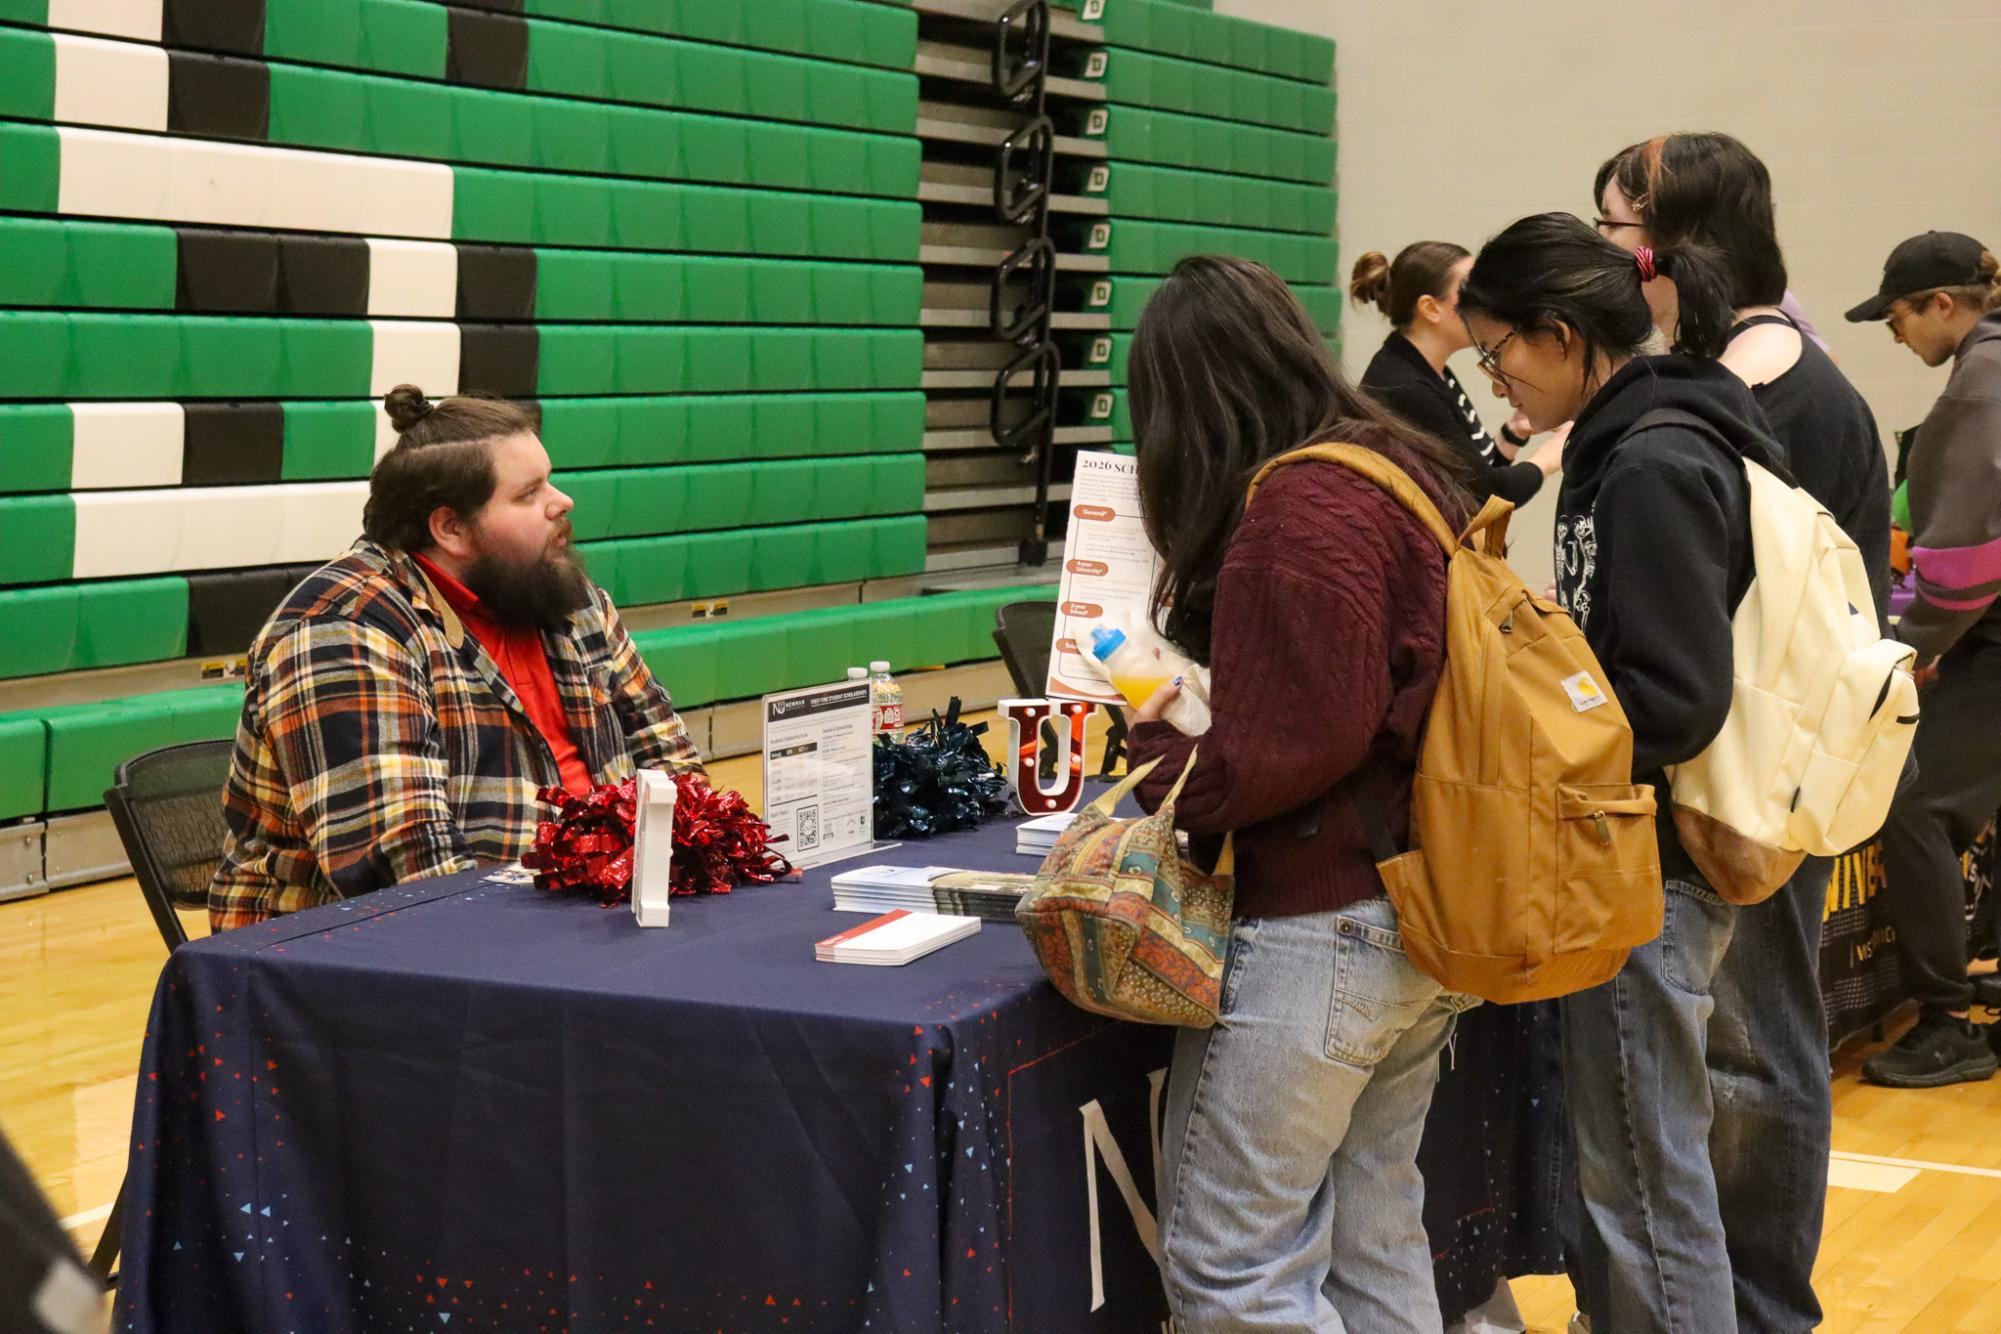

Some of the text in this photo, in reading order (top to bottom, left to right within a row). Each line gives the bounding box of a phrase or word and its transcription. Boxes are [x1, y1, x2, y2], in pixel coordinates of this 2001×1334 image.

[1082, 459, 1112, 470] 2026
[785, 700, 805, 708] NEWMAN
[998, 699, 1098, 817] U
